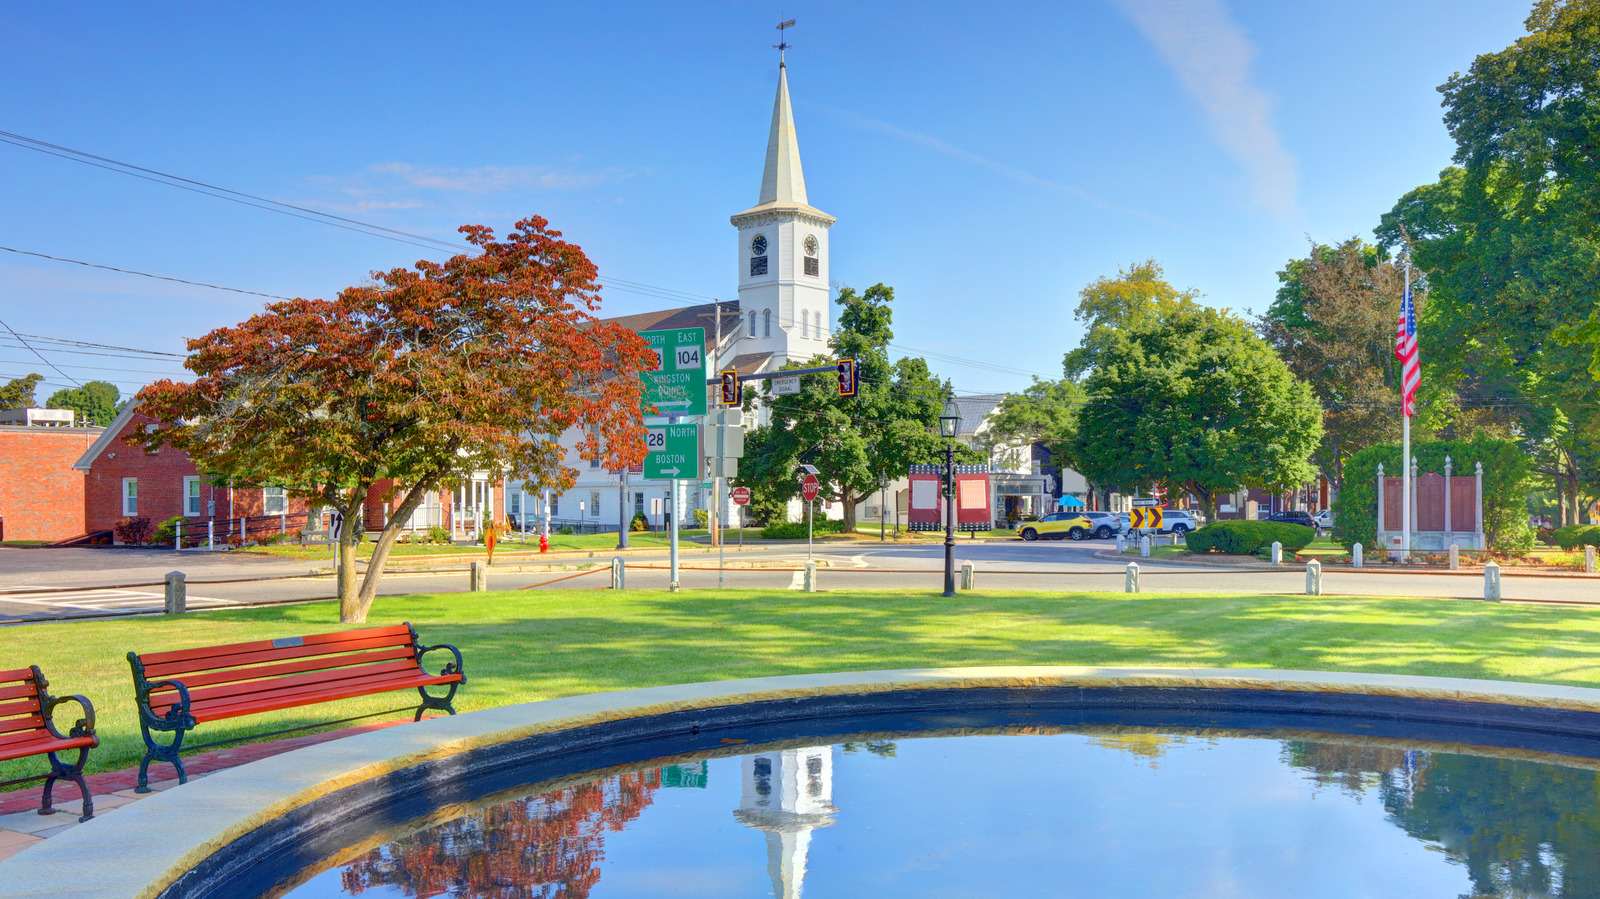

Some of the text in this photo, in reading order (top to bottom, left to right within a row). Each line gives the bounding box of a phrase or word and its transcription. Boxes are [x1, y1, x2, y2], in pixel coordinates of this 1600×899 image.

[678, 332, 696, 342] EAST
[678, 350, 698, 364] 104
[670, 427, 695, 437] NORTH
[648, 433, 664, 446] 28
[656, 454, 685, 463] BOSTON
[804, 483, 817, 493] STOP
